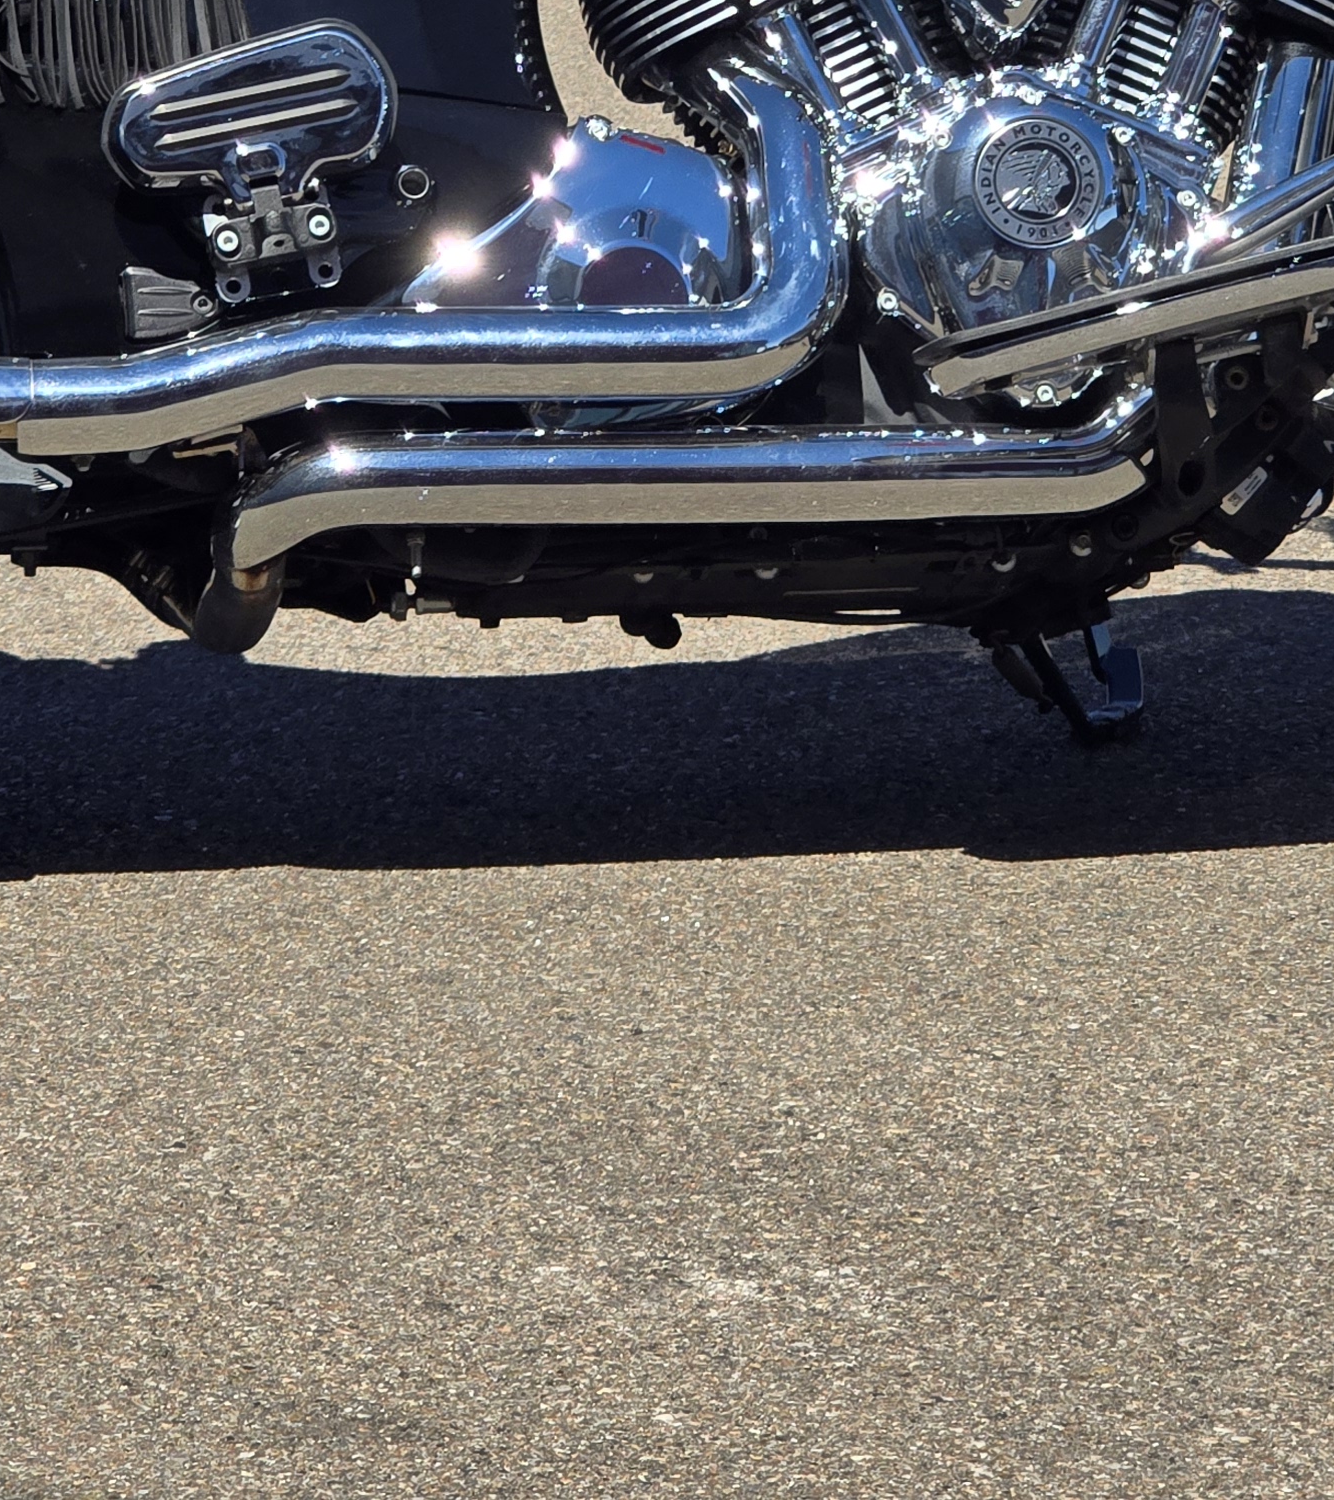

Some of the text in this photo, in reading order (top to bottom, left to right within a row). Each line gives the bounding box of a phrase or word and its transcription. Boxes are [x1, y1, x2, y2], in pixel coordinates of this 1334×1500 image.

[980, 124, 1096, 219] INDIAN MOTORCYCLE
[1016, 223, 1059, 238] 1901
